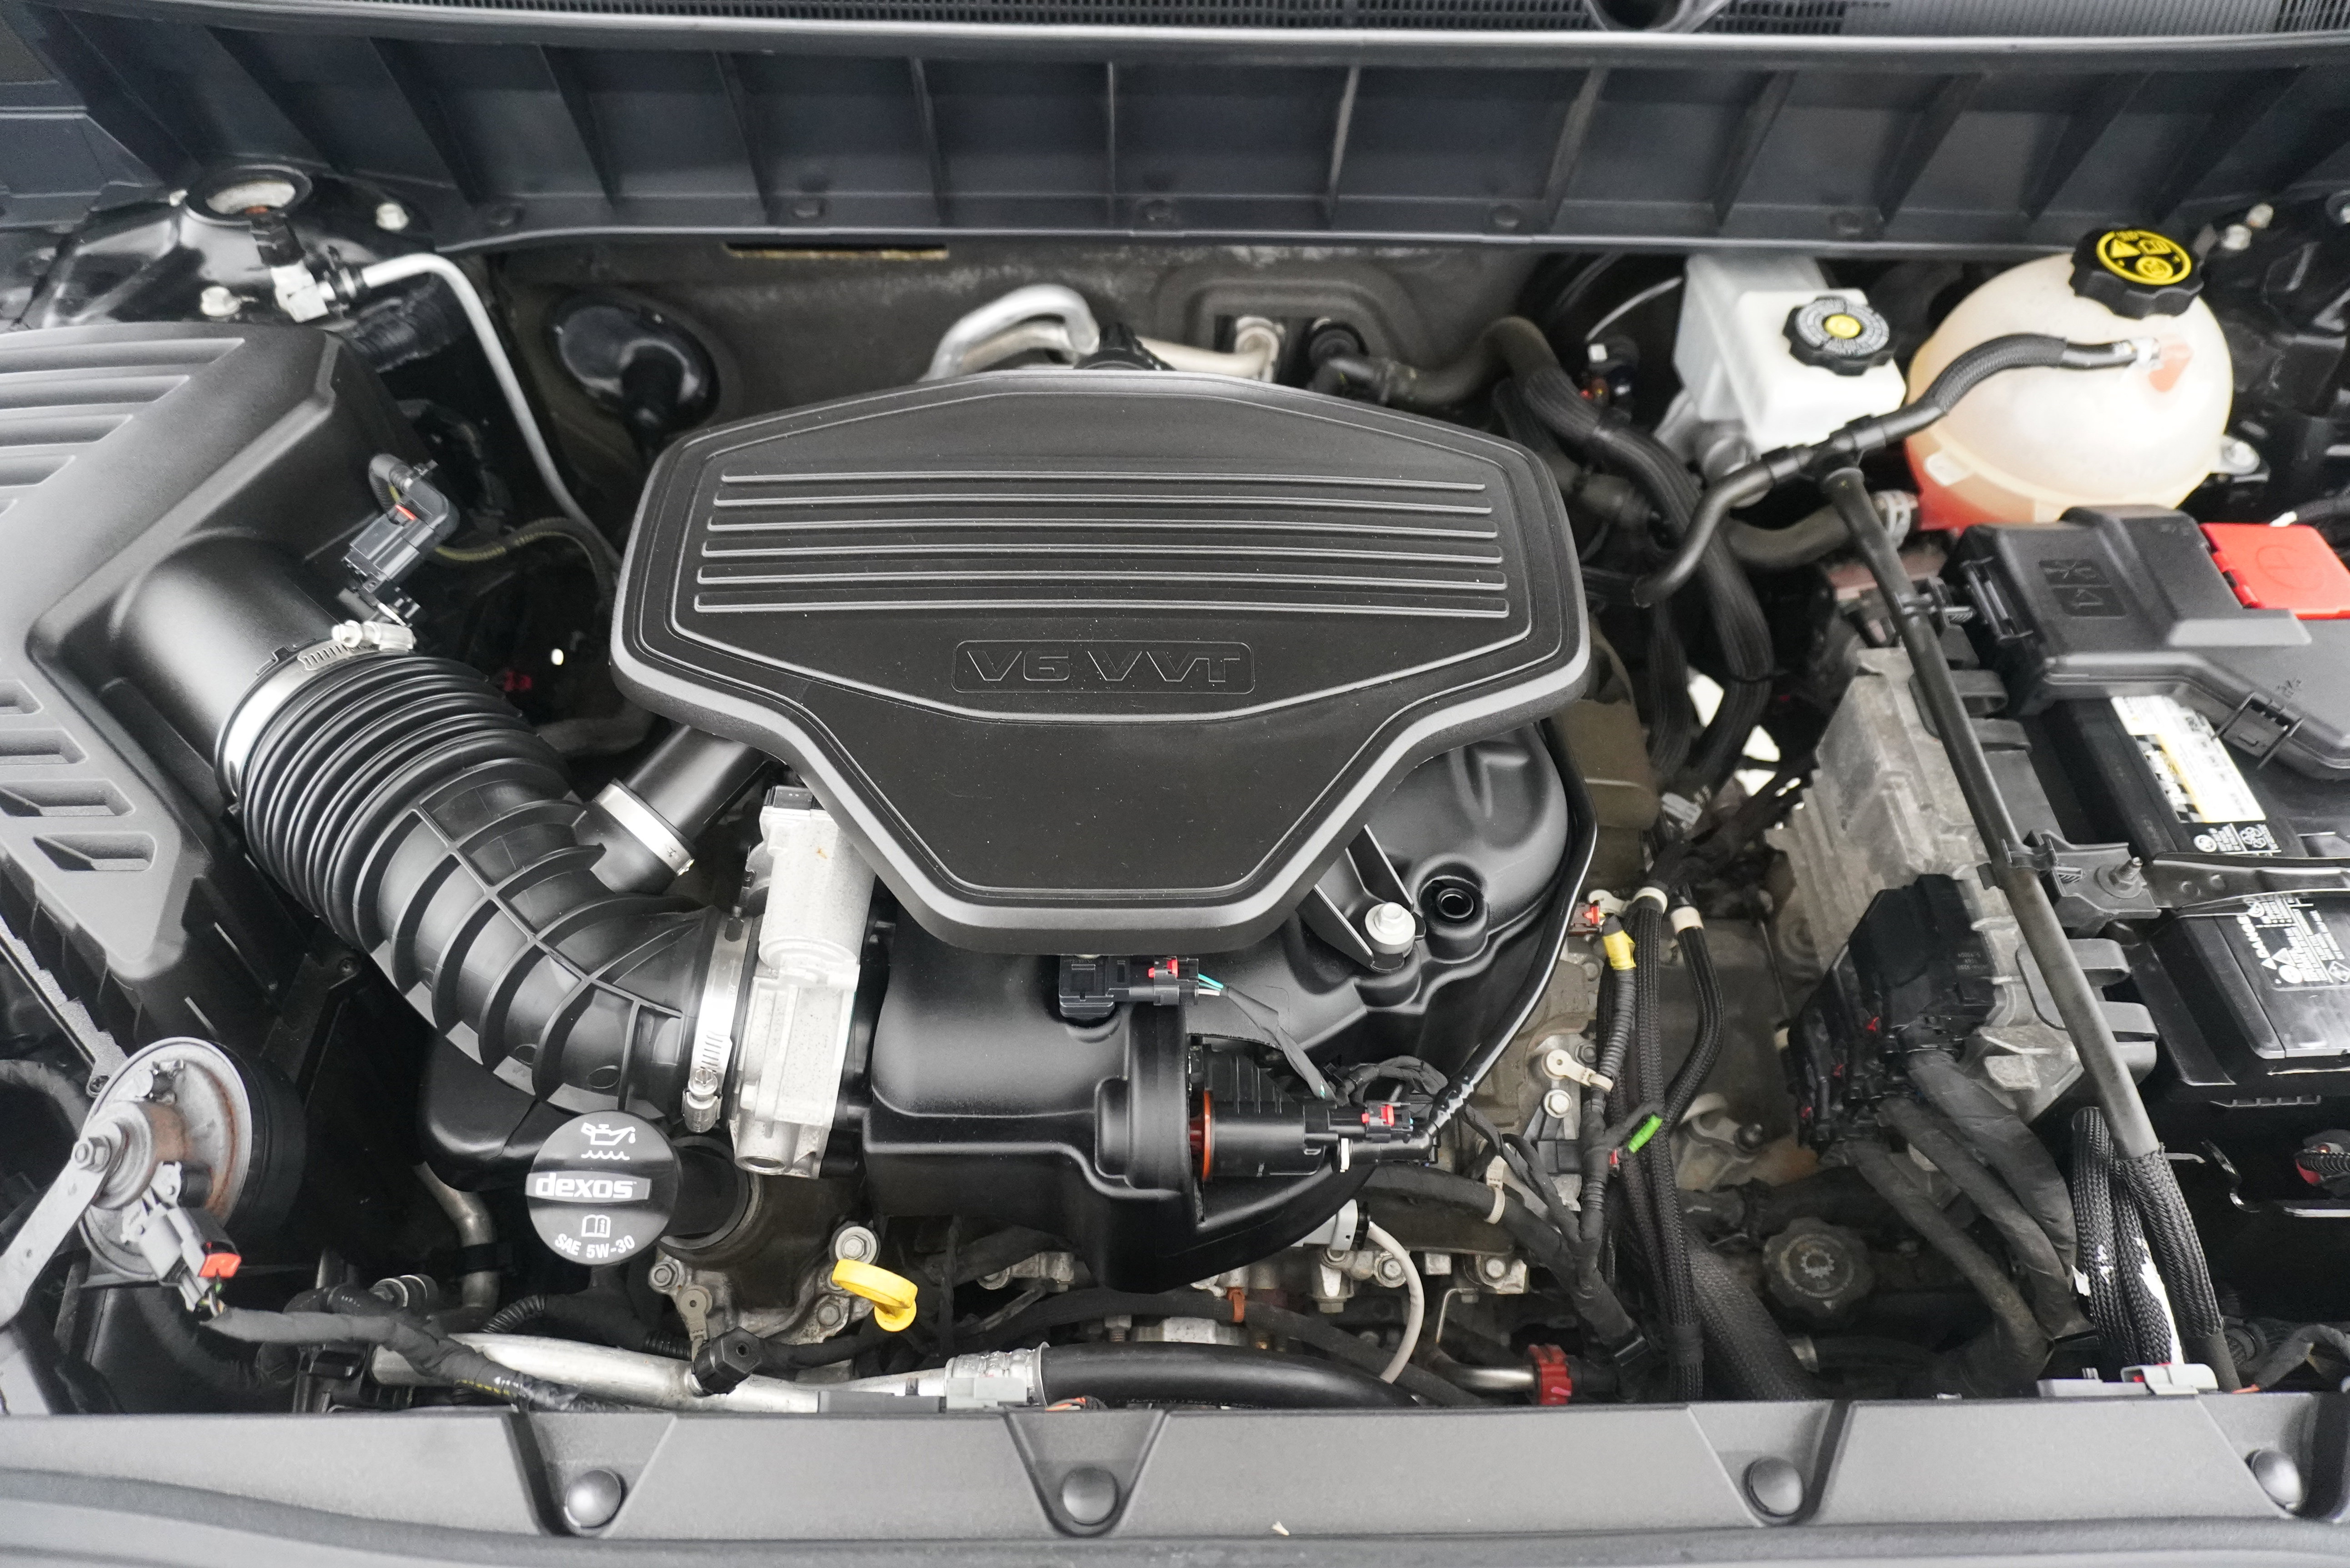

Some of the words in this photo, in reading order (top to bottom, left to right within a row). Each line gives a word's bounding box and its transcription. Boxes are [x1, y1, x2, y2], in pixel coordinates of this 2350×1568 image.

[967, 651, 1070, 681] V6
[1087, 651, 1240, 683] VVT
[535, 1172, 633, 1198] dexos
[554, 1233, 582, 1256] SAE
[586, 1235, 636, 1259] 5W-30
